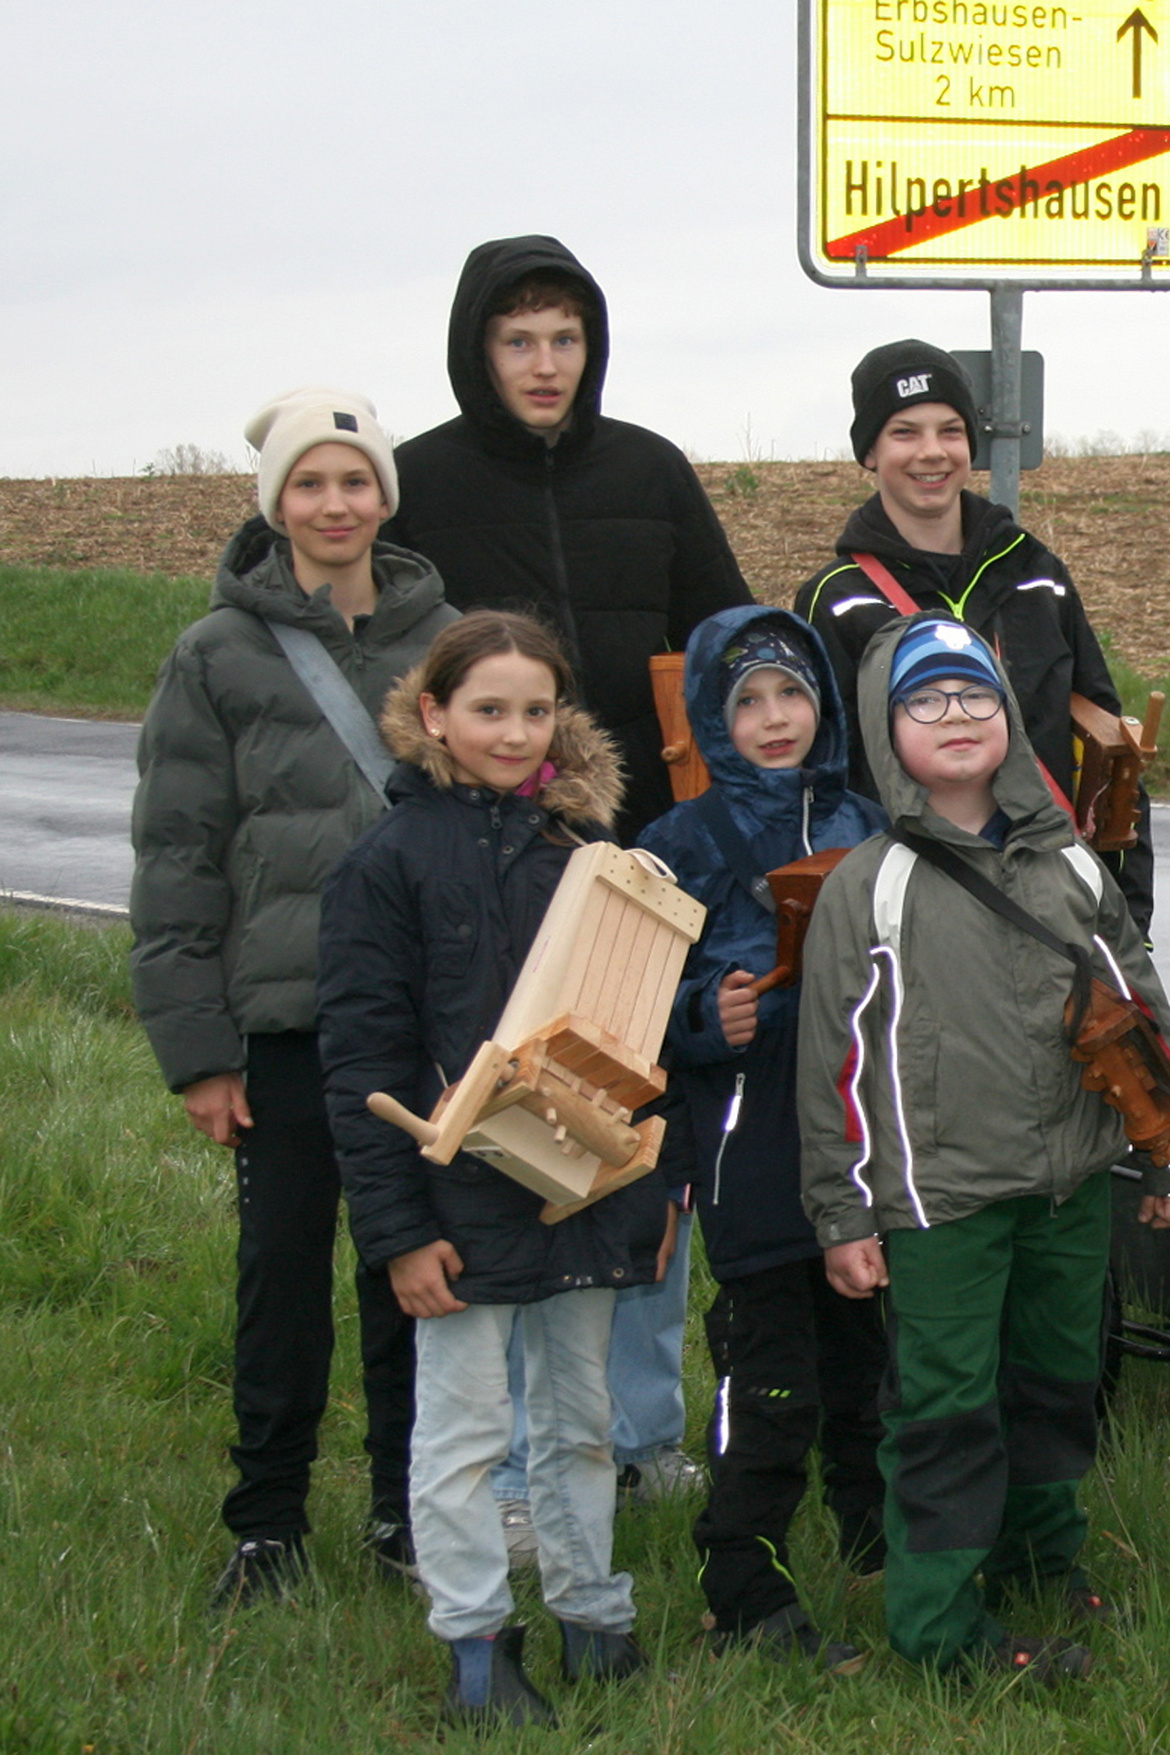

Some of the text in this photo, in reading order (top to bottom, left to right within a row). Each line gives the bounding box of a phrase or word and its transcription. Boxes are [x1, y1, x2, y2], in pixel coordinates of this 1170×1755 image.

[875, 0, 1082, 29] Erbshausen-
[876, 29, 1061, 68] Sulzwiesen
[935, 74, 1015, 108] 2 km
[845, 160, 1161, 232] Hilpertshausen
[896, 374, 930, 398] CAT
